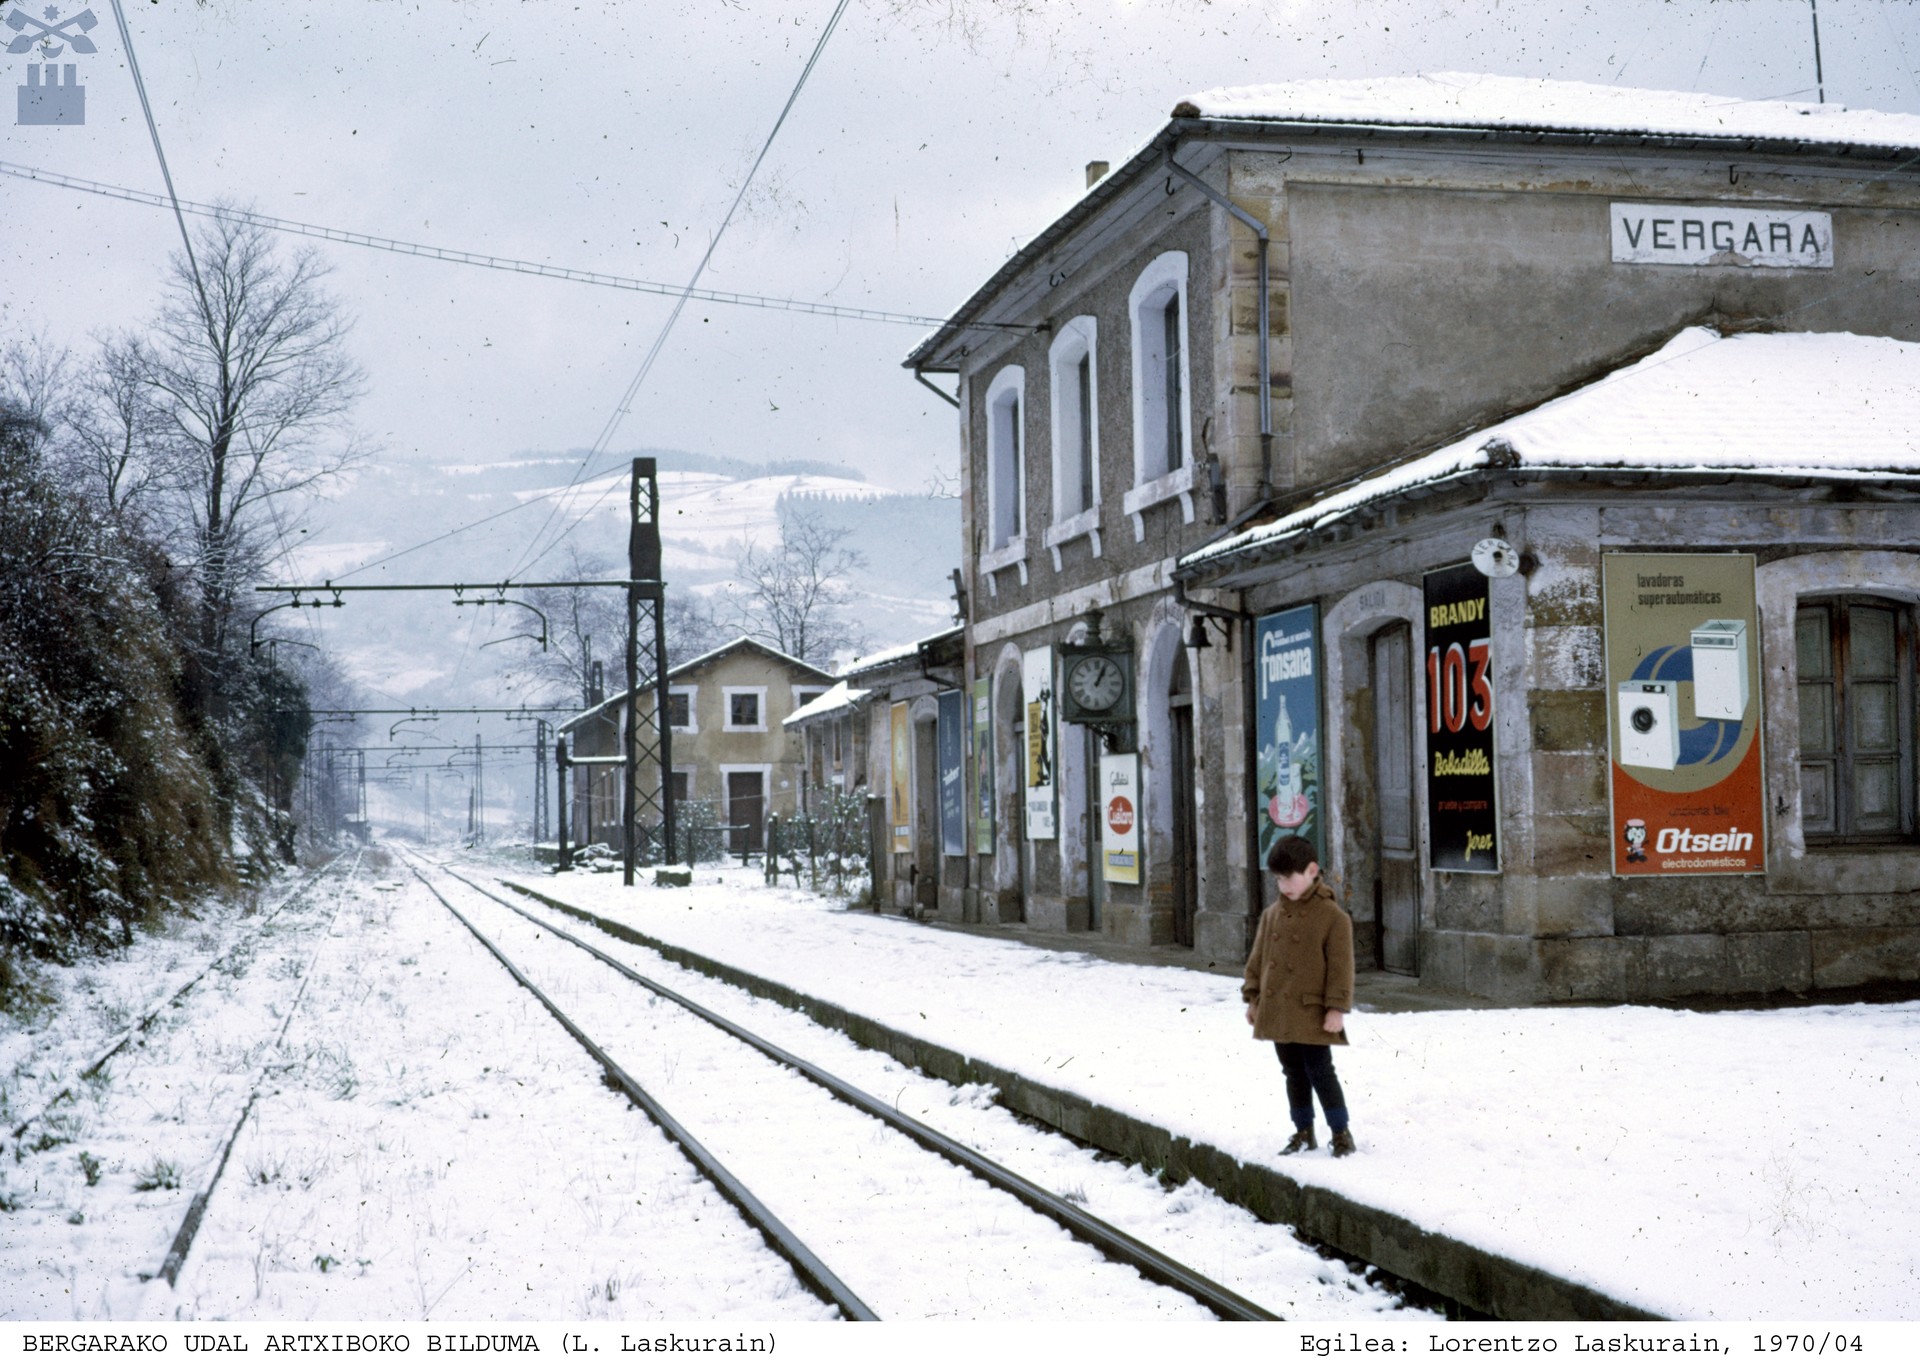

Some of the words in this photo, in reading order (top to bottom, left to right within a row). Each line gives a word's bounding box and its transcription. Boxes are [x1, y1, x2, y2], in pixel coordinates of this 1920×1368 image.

[1622, 217, 1821, 253] VERGARA
[1637, 573, 1684, 588] lavadoras
[1430, 597, 1486, 629] BRANDY
[1427, 637, 1492, 734] 103
[1434, 748, 1491, 777] Bobadilla
[1655, 827, 1754, 854] Otsein
